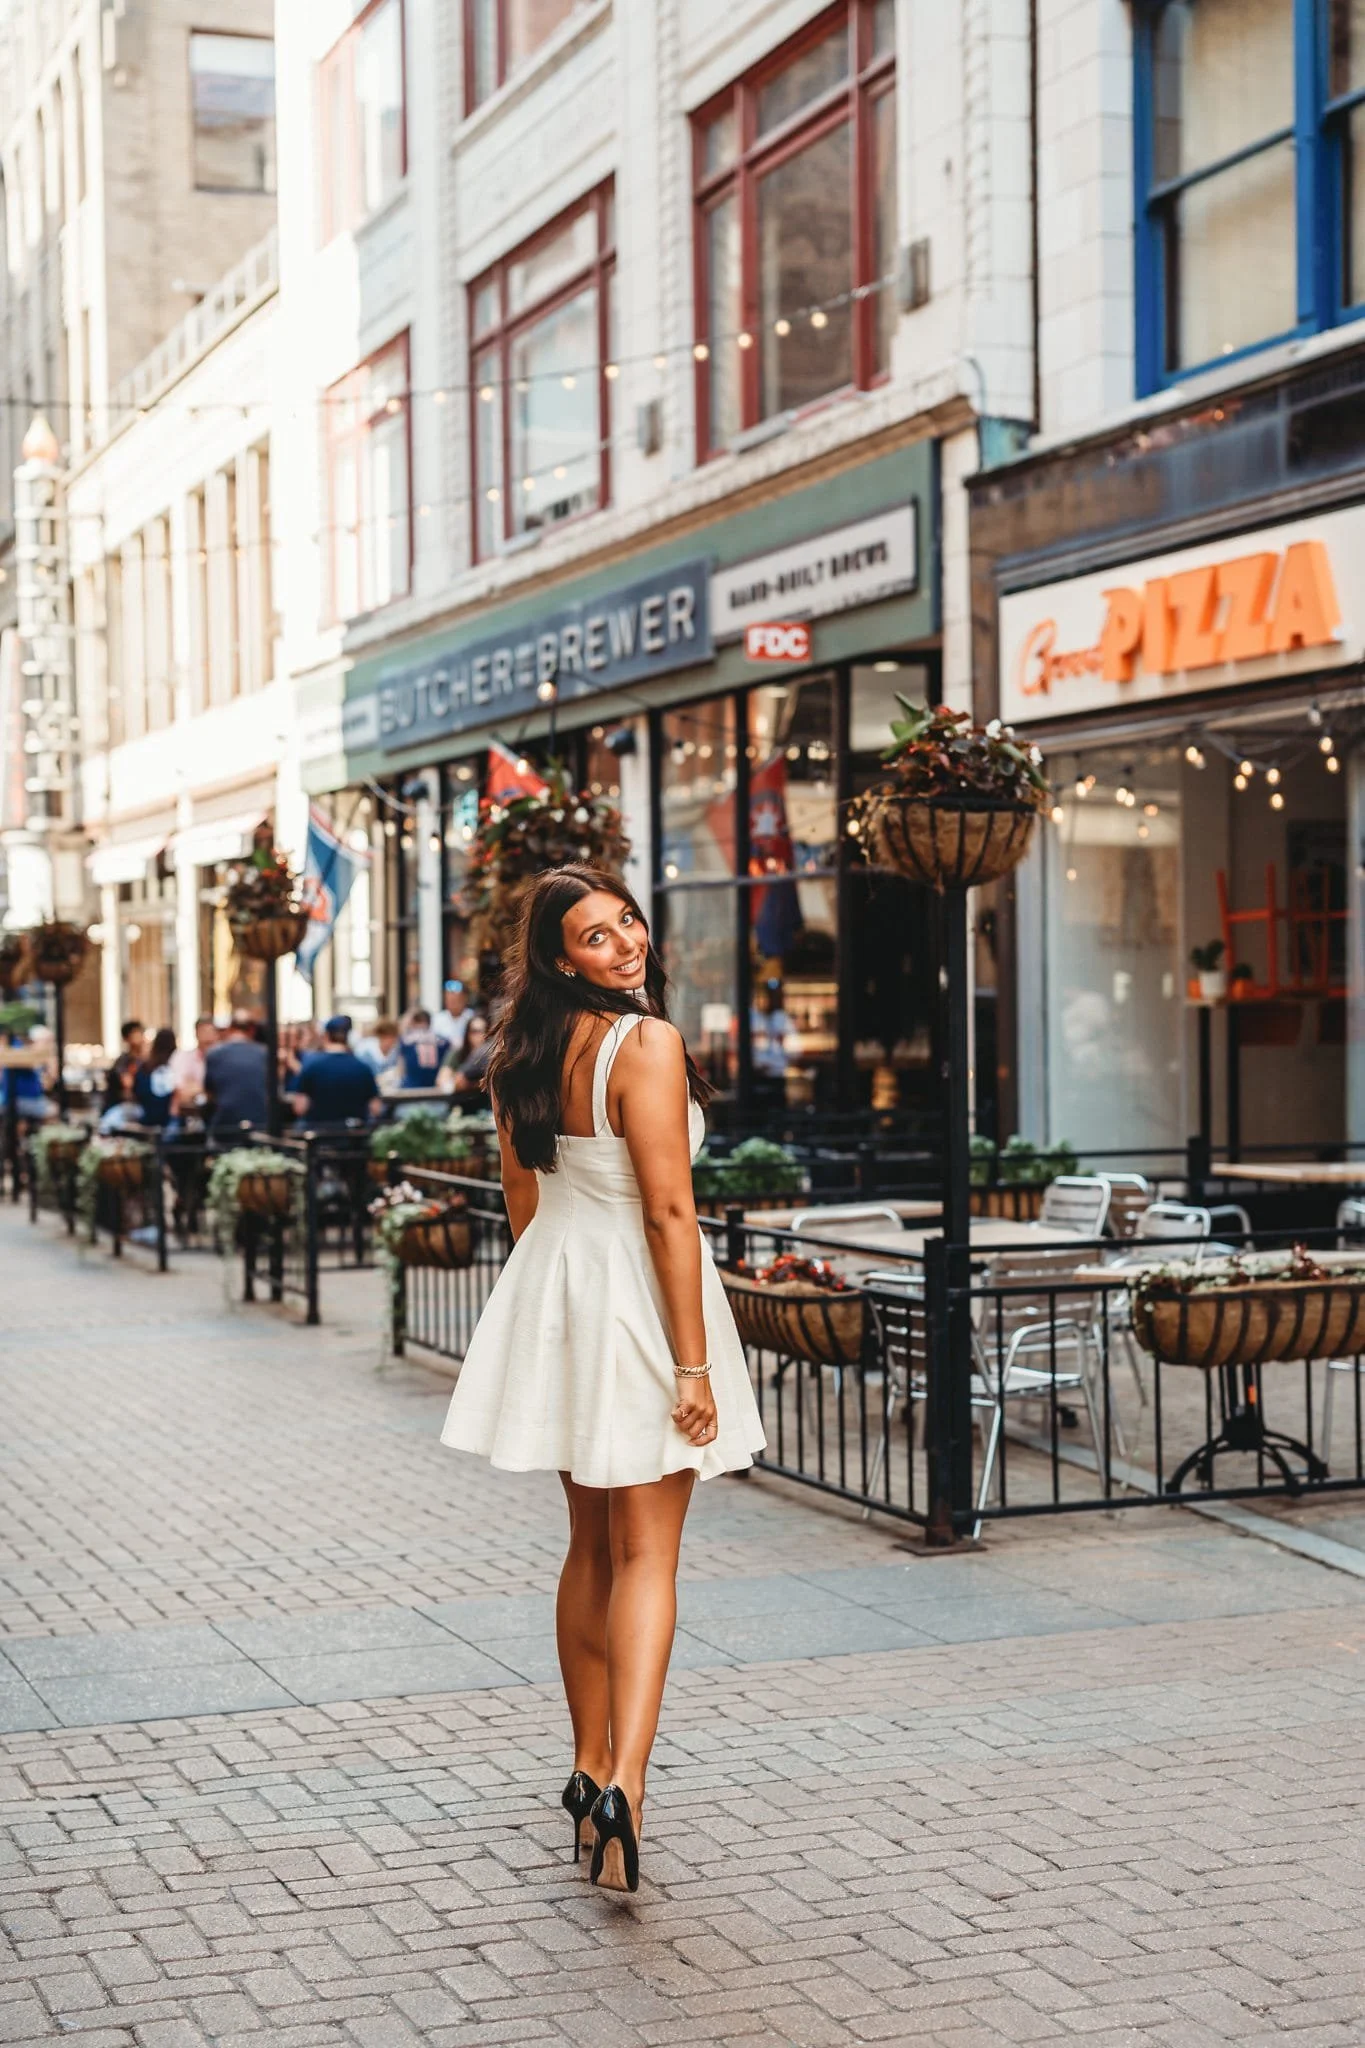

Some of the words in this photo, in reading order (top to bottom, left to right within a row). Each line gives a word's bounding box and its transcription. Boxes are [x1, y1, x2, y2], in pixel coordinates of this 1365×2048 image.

[379, 647, 514, 734] BUTCHER
[536, 584, 696, 684] BREWER
[747, 626, 809, 658] FDC
[1100, 539, 1341, 682] PIZZA
